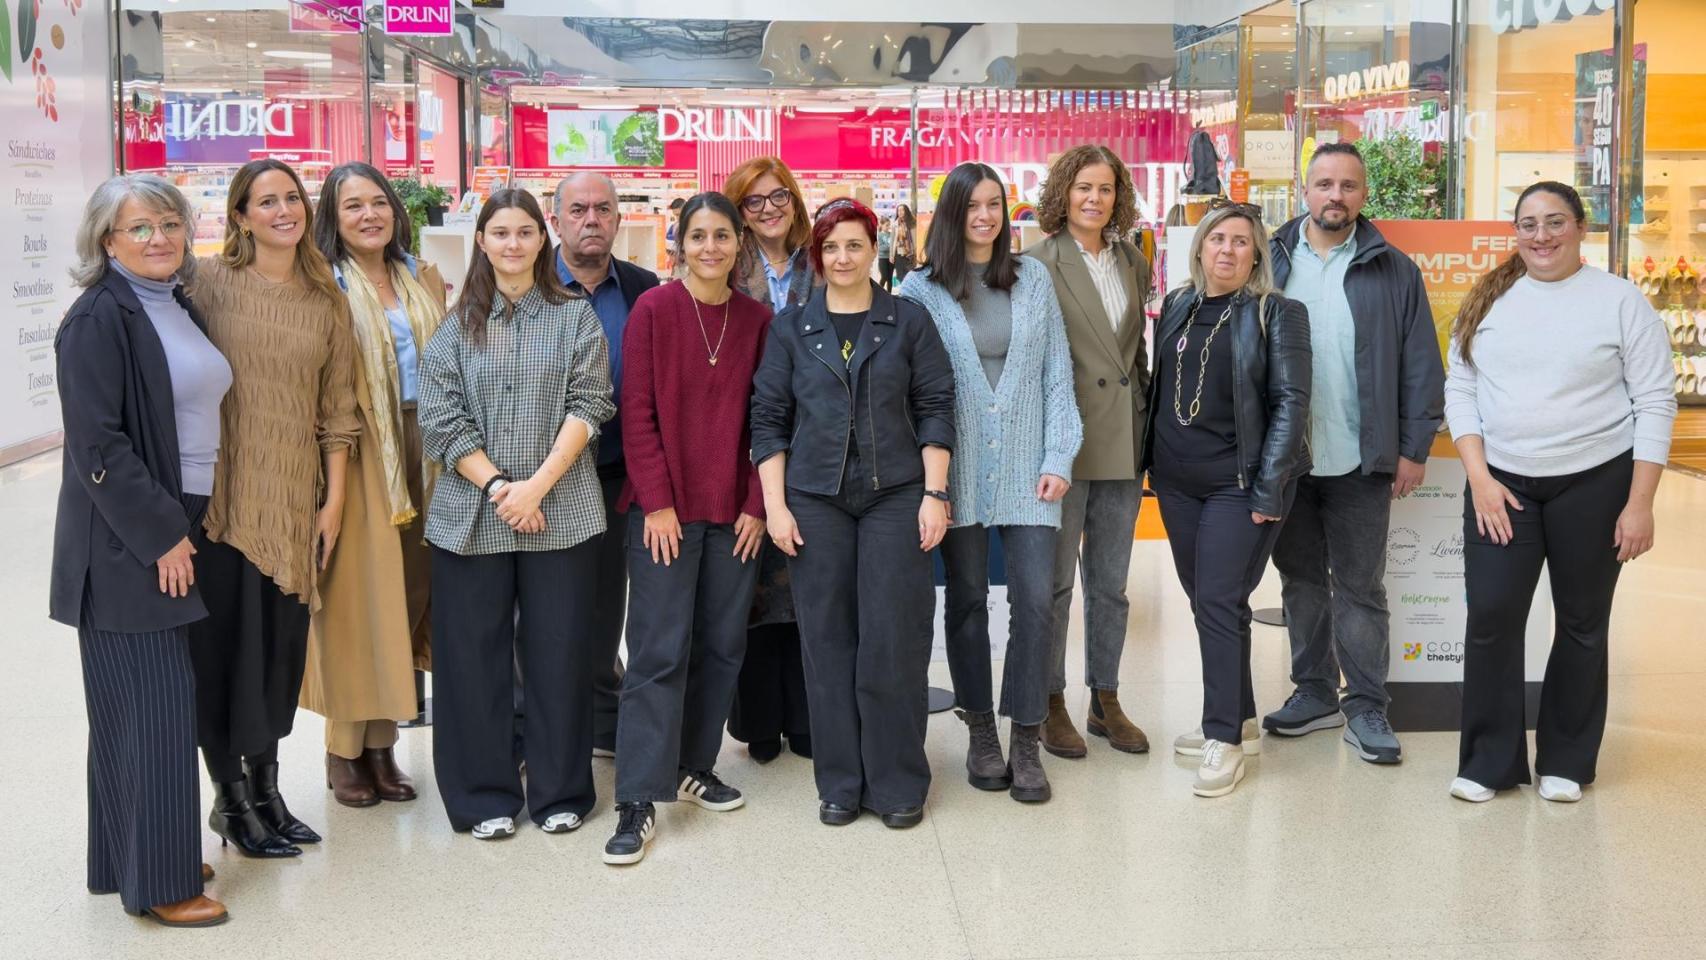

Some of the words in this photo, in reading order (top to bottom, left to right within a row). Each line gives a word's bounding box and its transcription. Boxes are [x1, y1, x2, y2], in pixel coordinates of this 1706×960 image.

[388, 6, 449, 24] DRUNI
[1324, 72, 1361, 103] ORO
[1363, 60, 1410, 91] VIVO
[657, 108, 774, 143] DRUNI
[1245, 142, 1274, 151] ORO
[23, 234, 48, 252] Bowls
[1452, 272, 1488, 285] ST
[13, 278, 54, 298] Smoothies
[28, 372, 54, 390] Tostas
